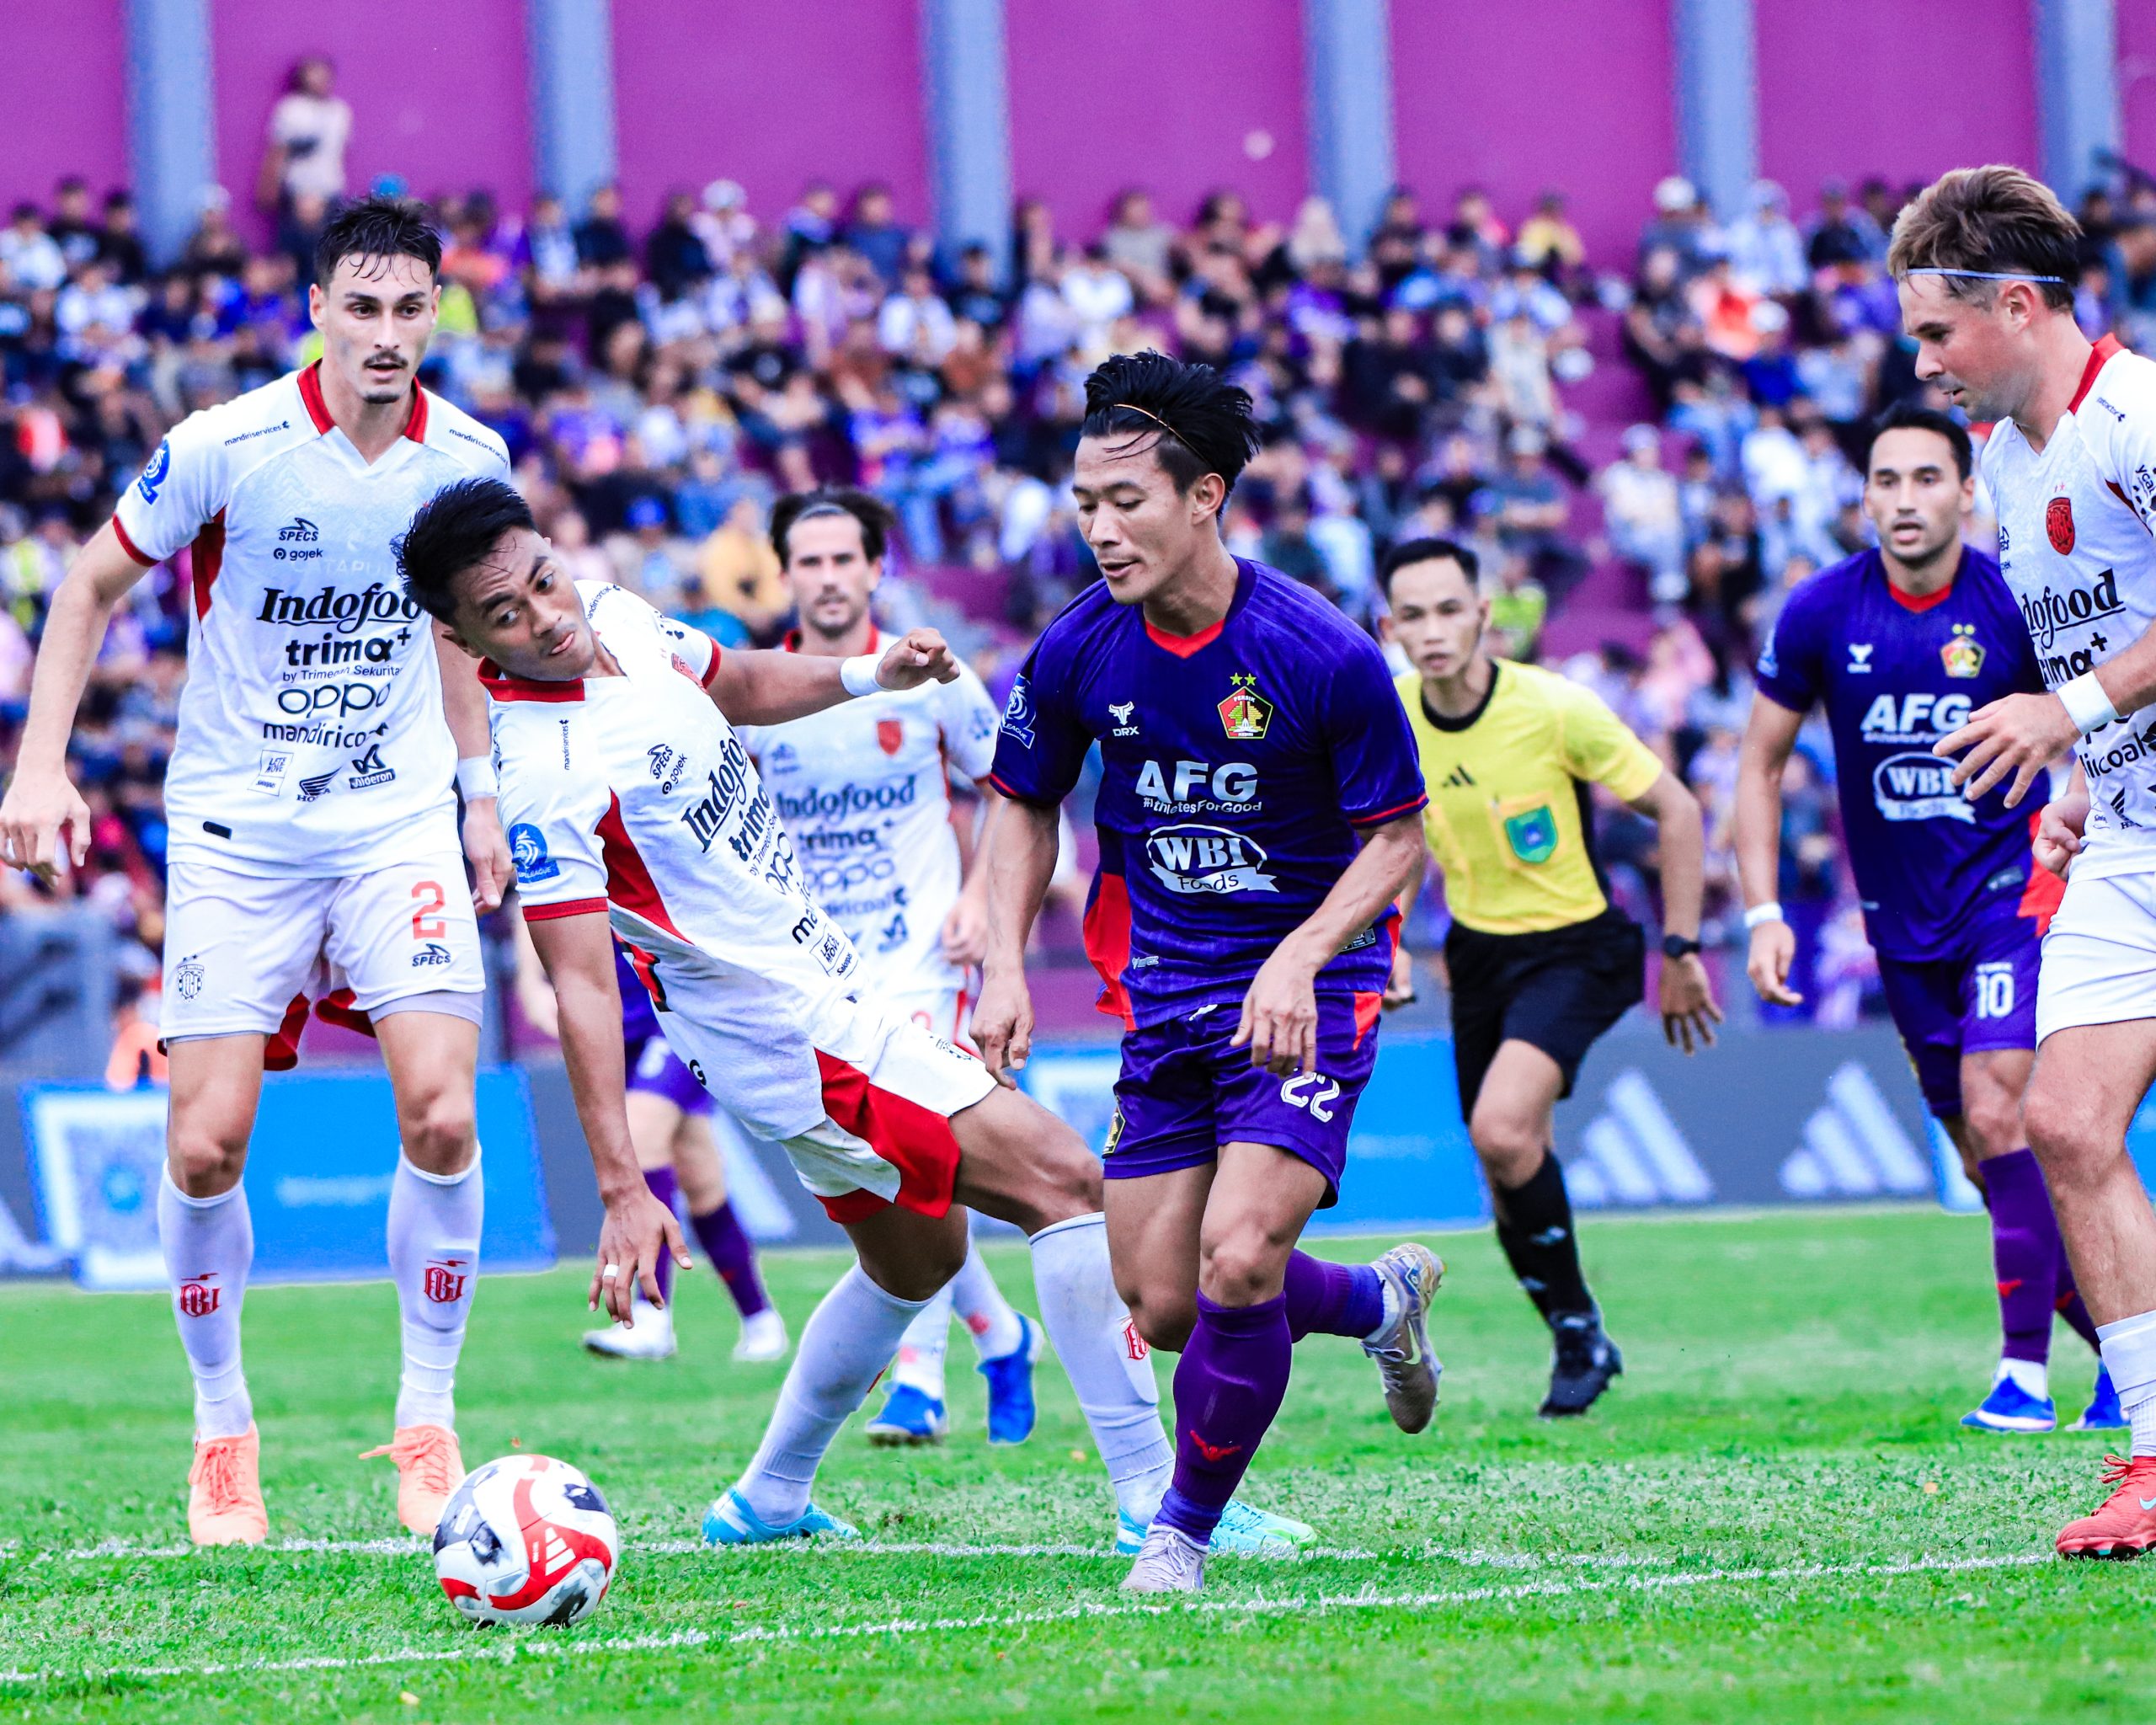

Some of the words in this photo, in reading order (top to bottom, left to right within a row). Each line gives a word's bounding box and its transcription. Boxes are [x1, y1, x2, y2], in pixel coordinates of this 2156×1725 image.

[225, 425, 281, 446] mandiriservices
[279, 531, 319, 542] SPECS
[290, 547, 323, 561] gojek
[256, 582, 421, 633] Indofoo
[2021, 568, 2126, 649] dofood
[283, 671, 296, 683] by
[278, 683, 391, 718] oppo
[1860, 693, 1972, 733] AFG
[264, 722, 376, 748] mandirico
[560, 725, 570, 771] mandiriservices
[1113, 726, 1139, 737] DRX
[653, 745, 673, 779] SPECS
[670, 753, 688, 784] gojek
[352, 772, 393, 788] Alderon
[1135, 760, 1258, 804] AFG
[776, 775, 916, 825] Indofood
[1154, 836, 1248, 870] WBI
[411, 880, 446, 940] 2
[412, 954, 451, 967] SPECS
[1976, 972, 2015, 1020] 10
[1280, 1071, 1340, 1123] 22
